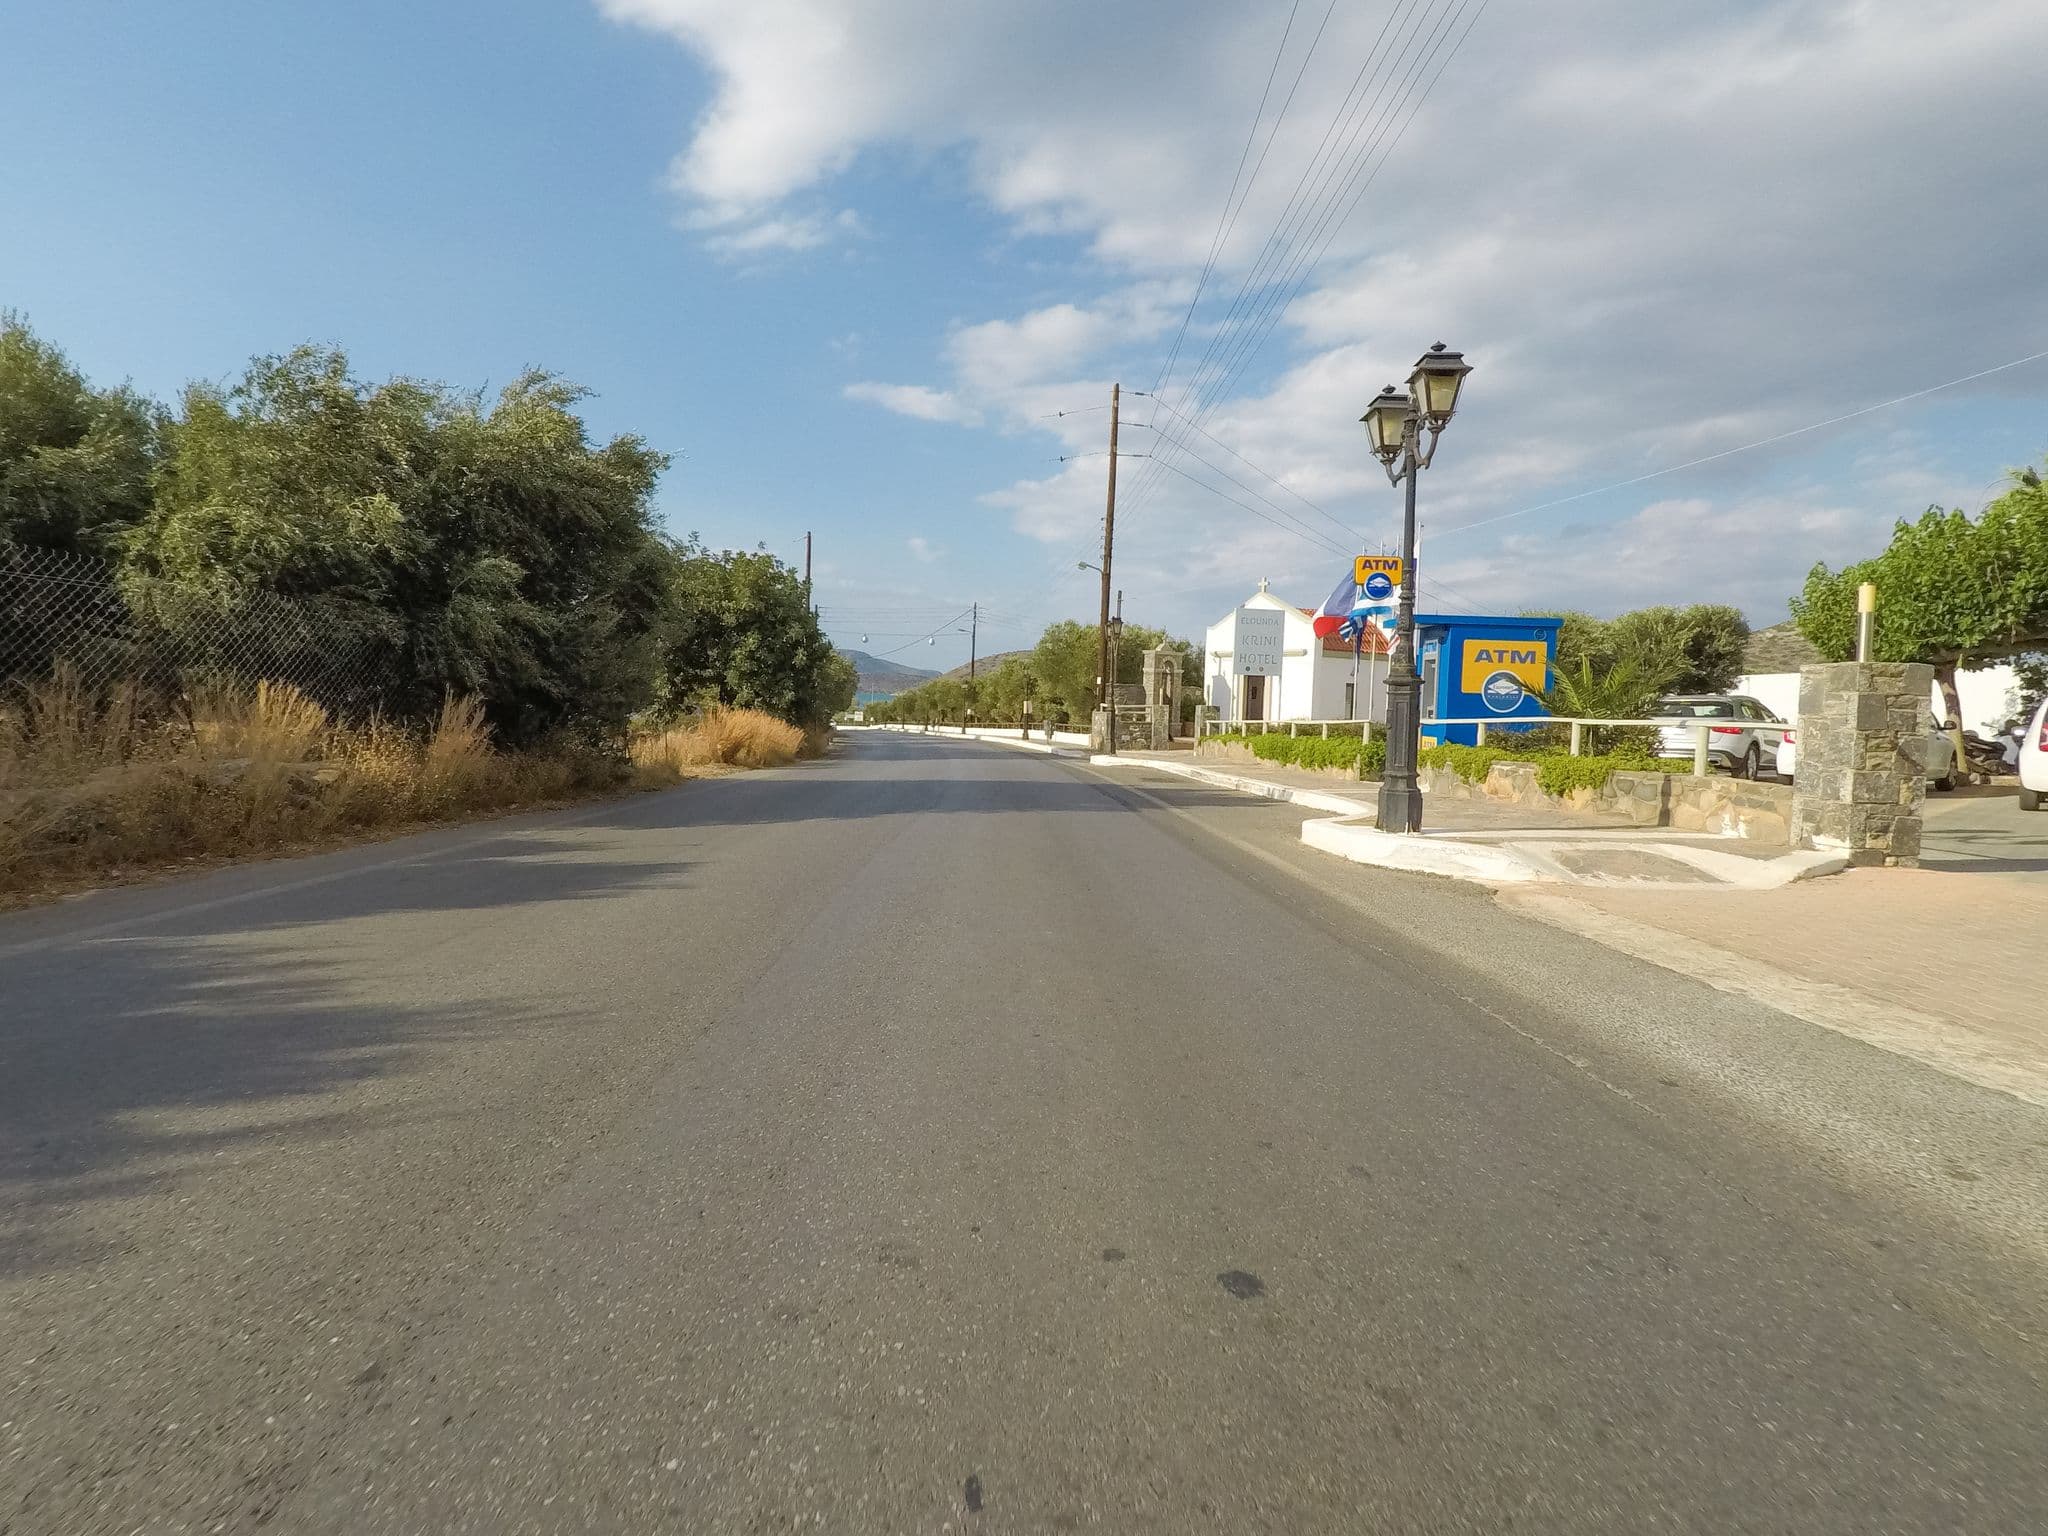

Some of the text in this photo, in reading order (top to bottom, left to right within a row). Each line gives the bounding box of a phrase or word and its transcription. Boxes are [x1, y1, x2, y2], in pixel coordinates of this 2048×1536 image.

[1362, 559, 1398, 570] ATM
[1240, 616, 1280, 627] ELOUNDA
[1242, 635, 1277, 647] KRINI
[1239, 653, 1278, 665] HOTEL
[1474, 649, 1536, 664] ATM
